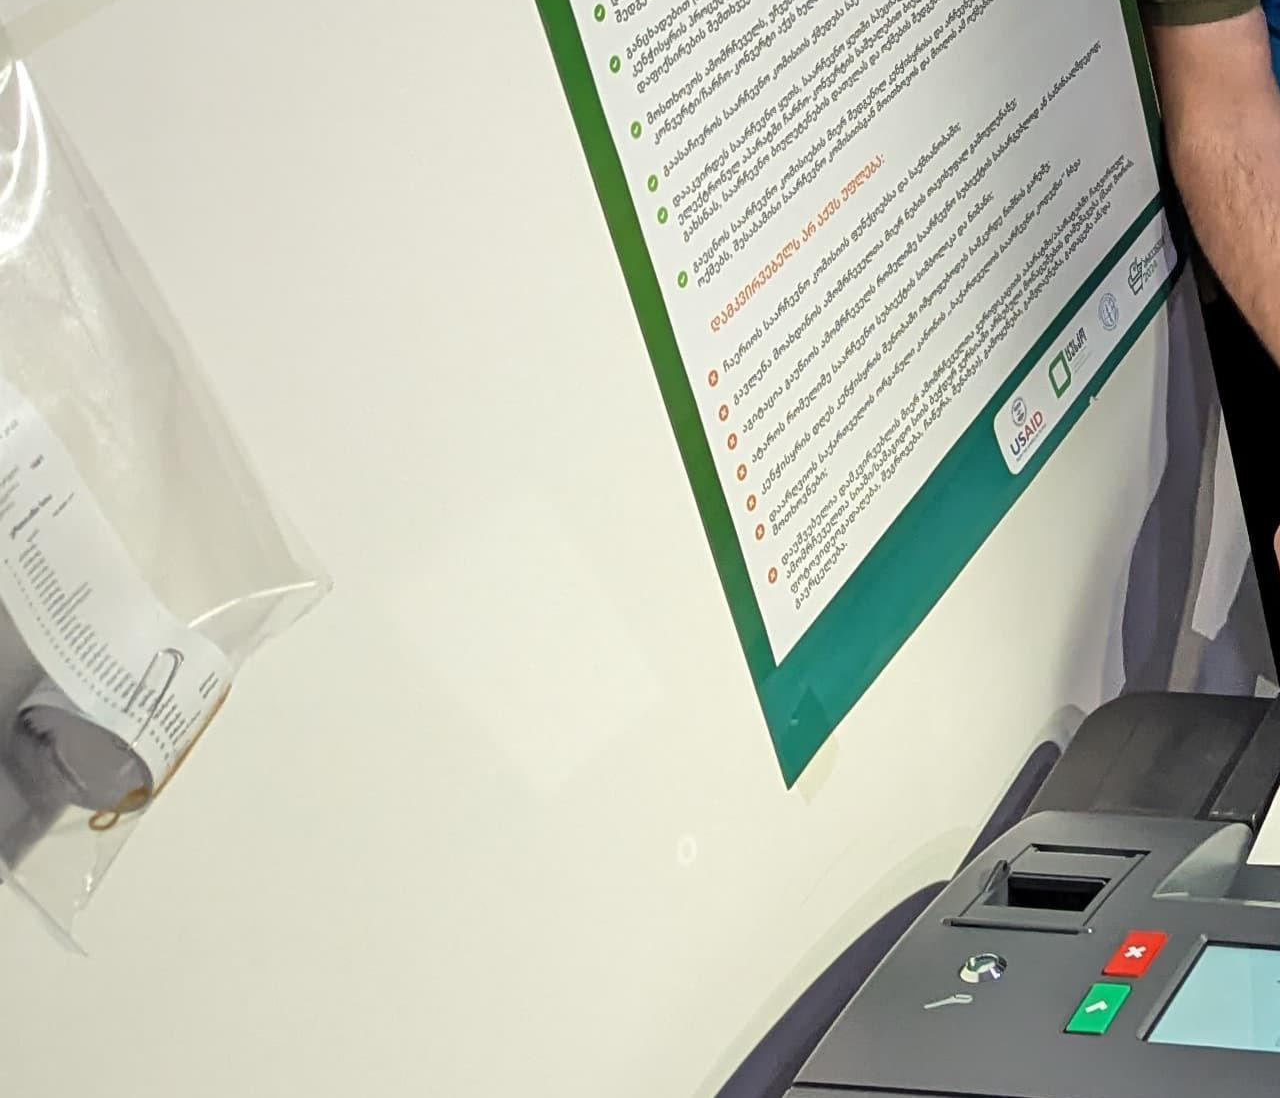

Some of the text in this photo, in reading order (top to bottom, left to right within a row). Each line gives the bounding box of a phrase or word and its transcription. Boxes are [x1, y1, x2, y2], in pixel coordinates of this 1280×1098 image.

[632, 21, 688, 79] კენჭისყრის
[636, 27, 707, 95] დაფიქსირების
[646, 70, 704, 126] მოსთხოვოს
[662, 114, 723, 178] გაასაჩივროს
[720, 148, 771, 203] საარჩევნო
[671, 147, 730, 209] დააკვირდეს
[677, 159, 742, 227] ელექტრონულ
[692, 229, 731, 274] გაეცნოს
[729, 184, 779, 234] საარჩევნო
[710, 153, 885, 334] დამკვირვებელს არ აქვს უფლება:
[731, 200, 783, 253] შესაბამისი
[1010, 411, 1044, 455] USAID
